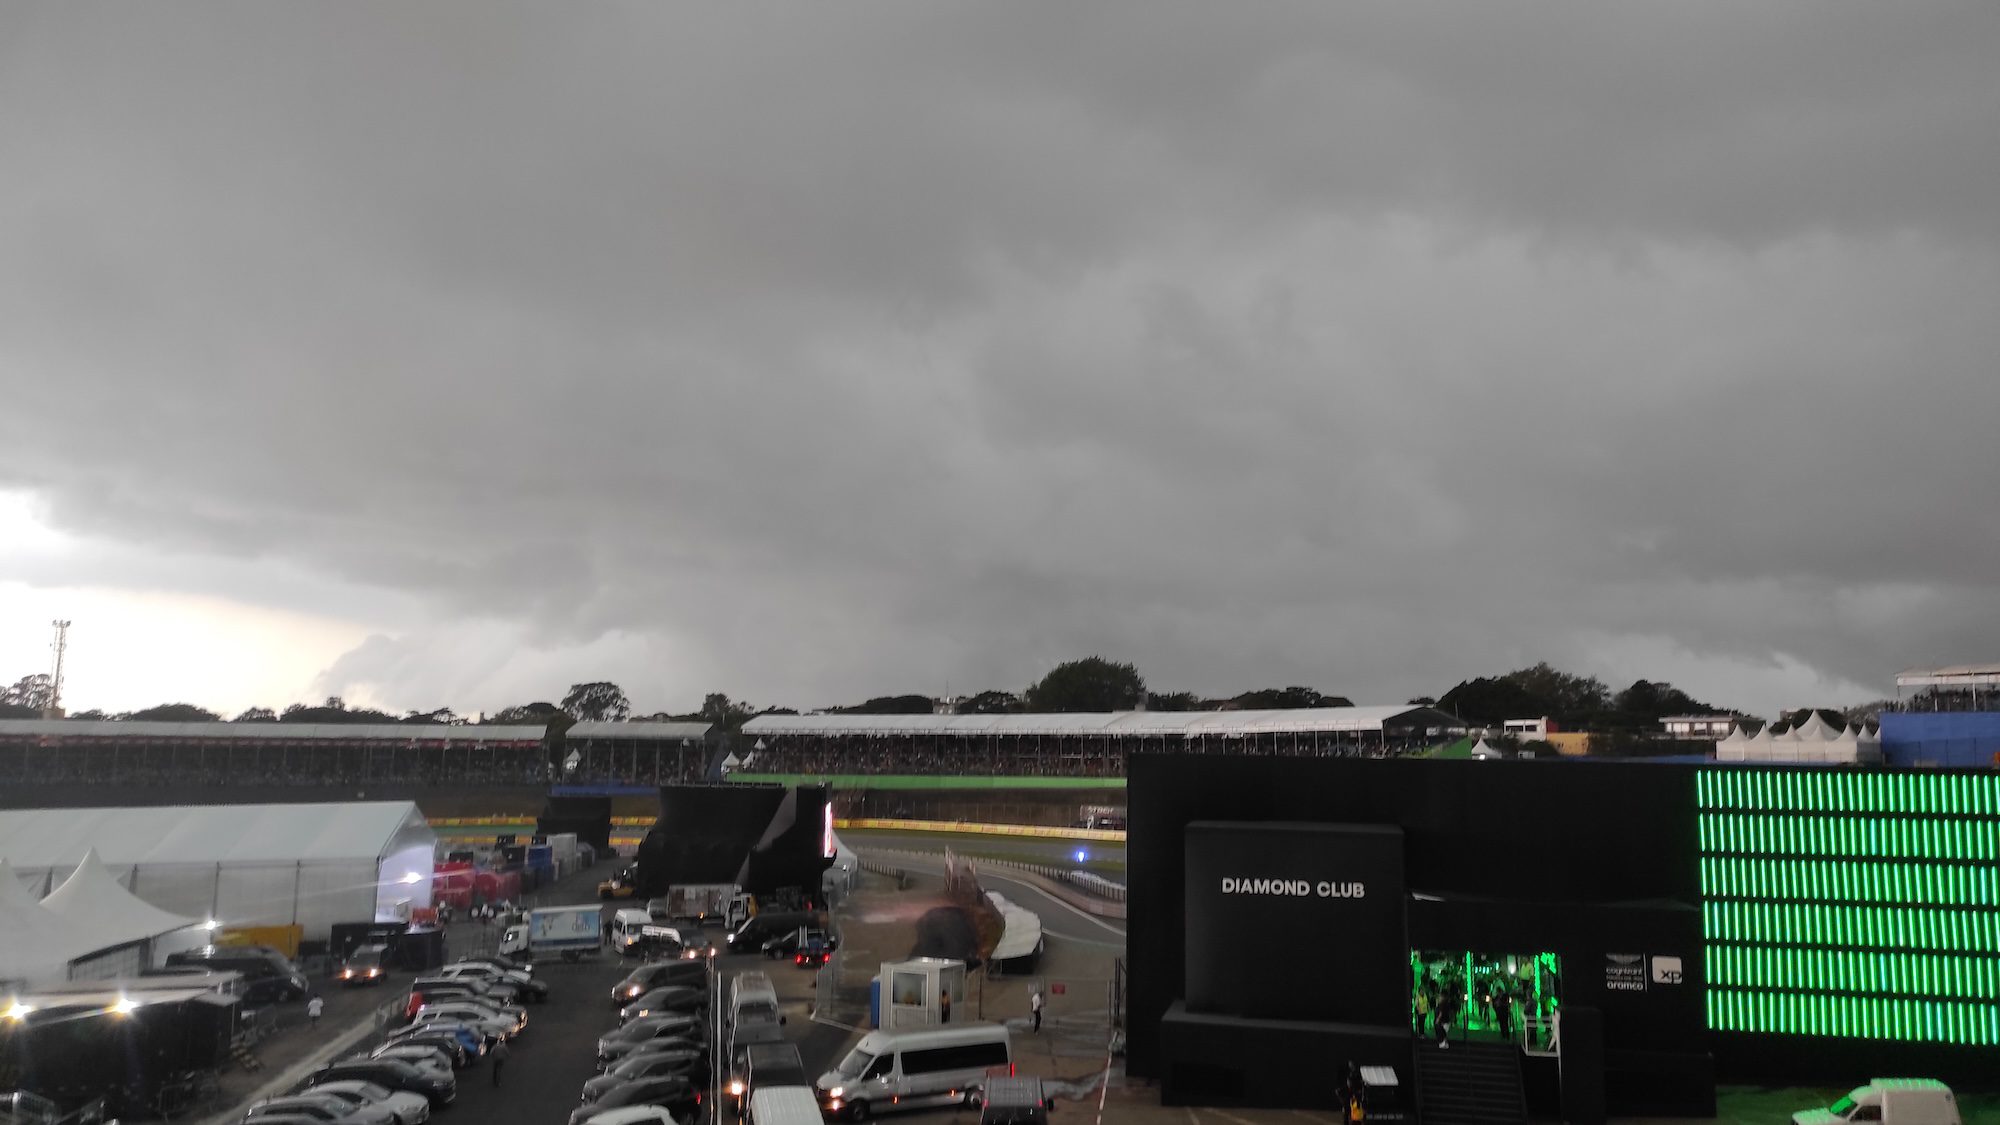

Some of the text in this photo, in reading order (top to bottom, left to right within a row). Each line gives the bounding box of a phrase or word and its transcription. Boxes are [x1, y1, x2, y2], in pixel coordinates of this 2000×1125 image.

[1222, 877, 1365, 898] DIAMOND CLUB
[1606, 981, 1644, 990] aramco
